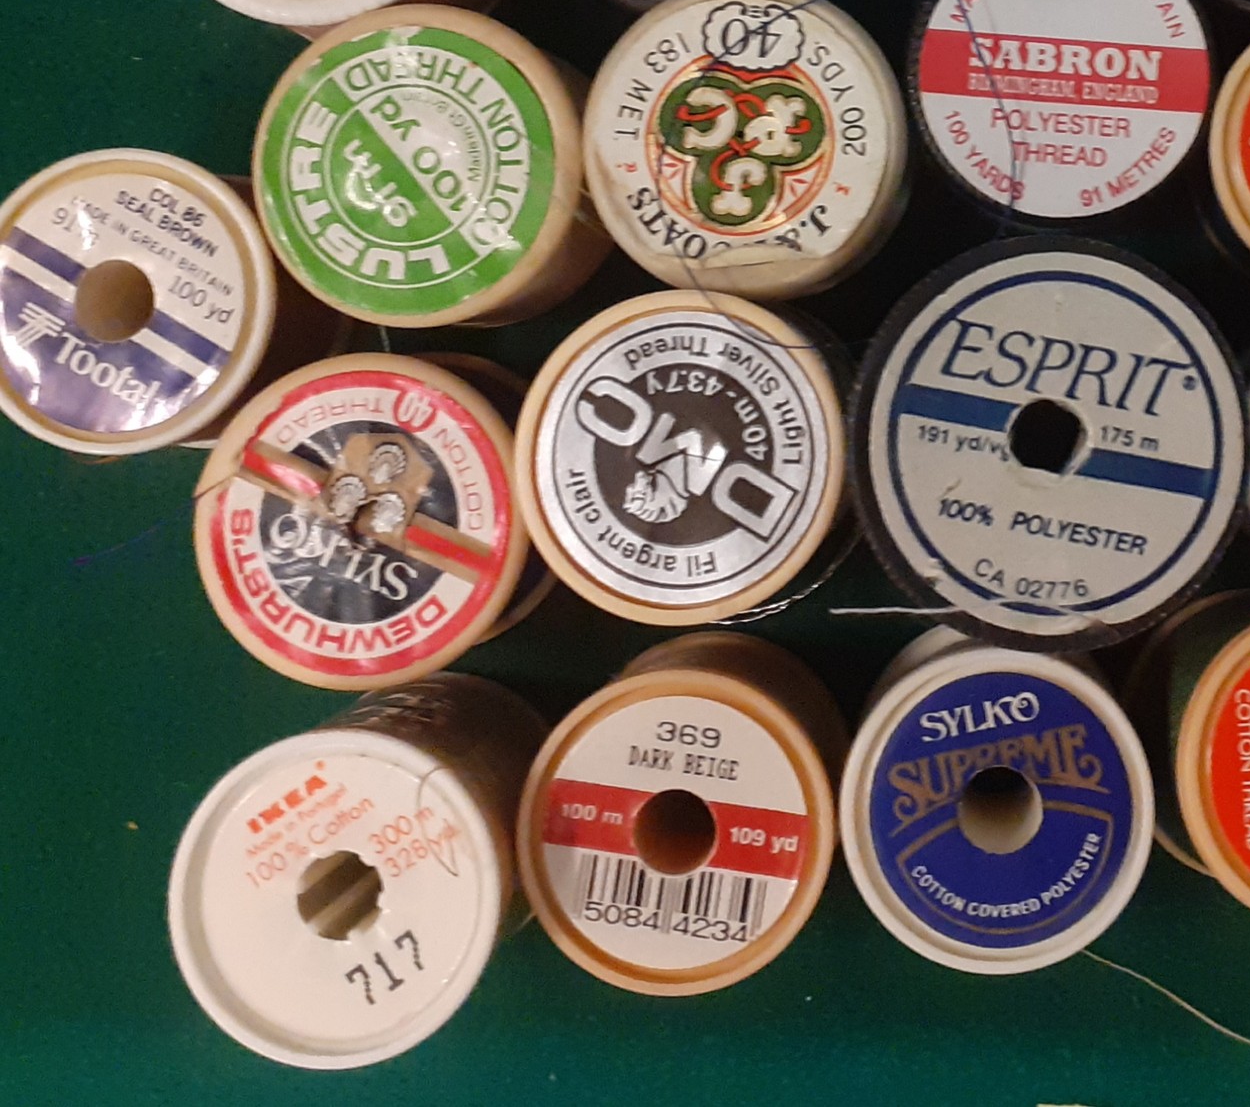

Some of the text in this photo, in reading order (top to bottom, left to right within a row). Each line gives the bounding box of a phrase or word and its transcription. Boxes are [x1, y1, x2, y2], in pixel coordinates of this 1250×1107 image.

[643, 33, 689, 73] 183
[722, 18, 782, 57] 40
[969, 37, 1162, 81] SABRON
[370, 95, 420, 141] yd
[841, 106, 865, 156] 200
[990, 107, 1130, 137] POLYESTER
[1011, 141, 1106, 167] THREAD
[289, 100, 451, 280] LUSTRE
[114, 191, 219, 257] SEAL BROWN
[168, 276, 234, 323] 100 yd
[54, 332, 161, 405] Tootal
[623, 335, 780, 397] Silver Thread
[278, 397, 383, 444] THREAD
[918, 425, 949, 443] 191
[1100, 425, 1159, 450] 175 m
[575, 376, 799, 542] DMC
[568, 468, 717, 576] Fil argent clair
[938, 498, 1148, 554] 100% POLYESTER
[975, 558, 1088, 599] CA 02776
[656, 721, 720, 748] 369
[919, 691, 1039, 742] SYLKO
[628, 745, 740, 781] DARK BEIGE
[369, 815, 412, 854] 300
[729, 826, 798, 853] 109 yd
[910, 832, 1102, 918] COTTON COVERED POLYESTER
[345, 929, 423, 1005] 717
